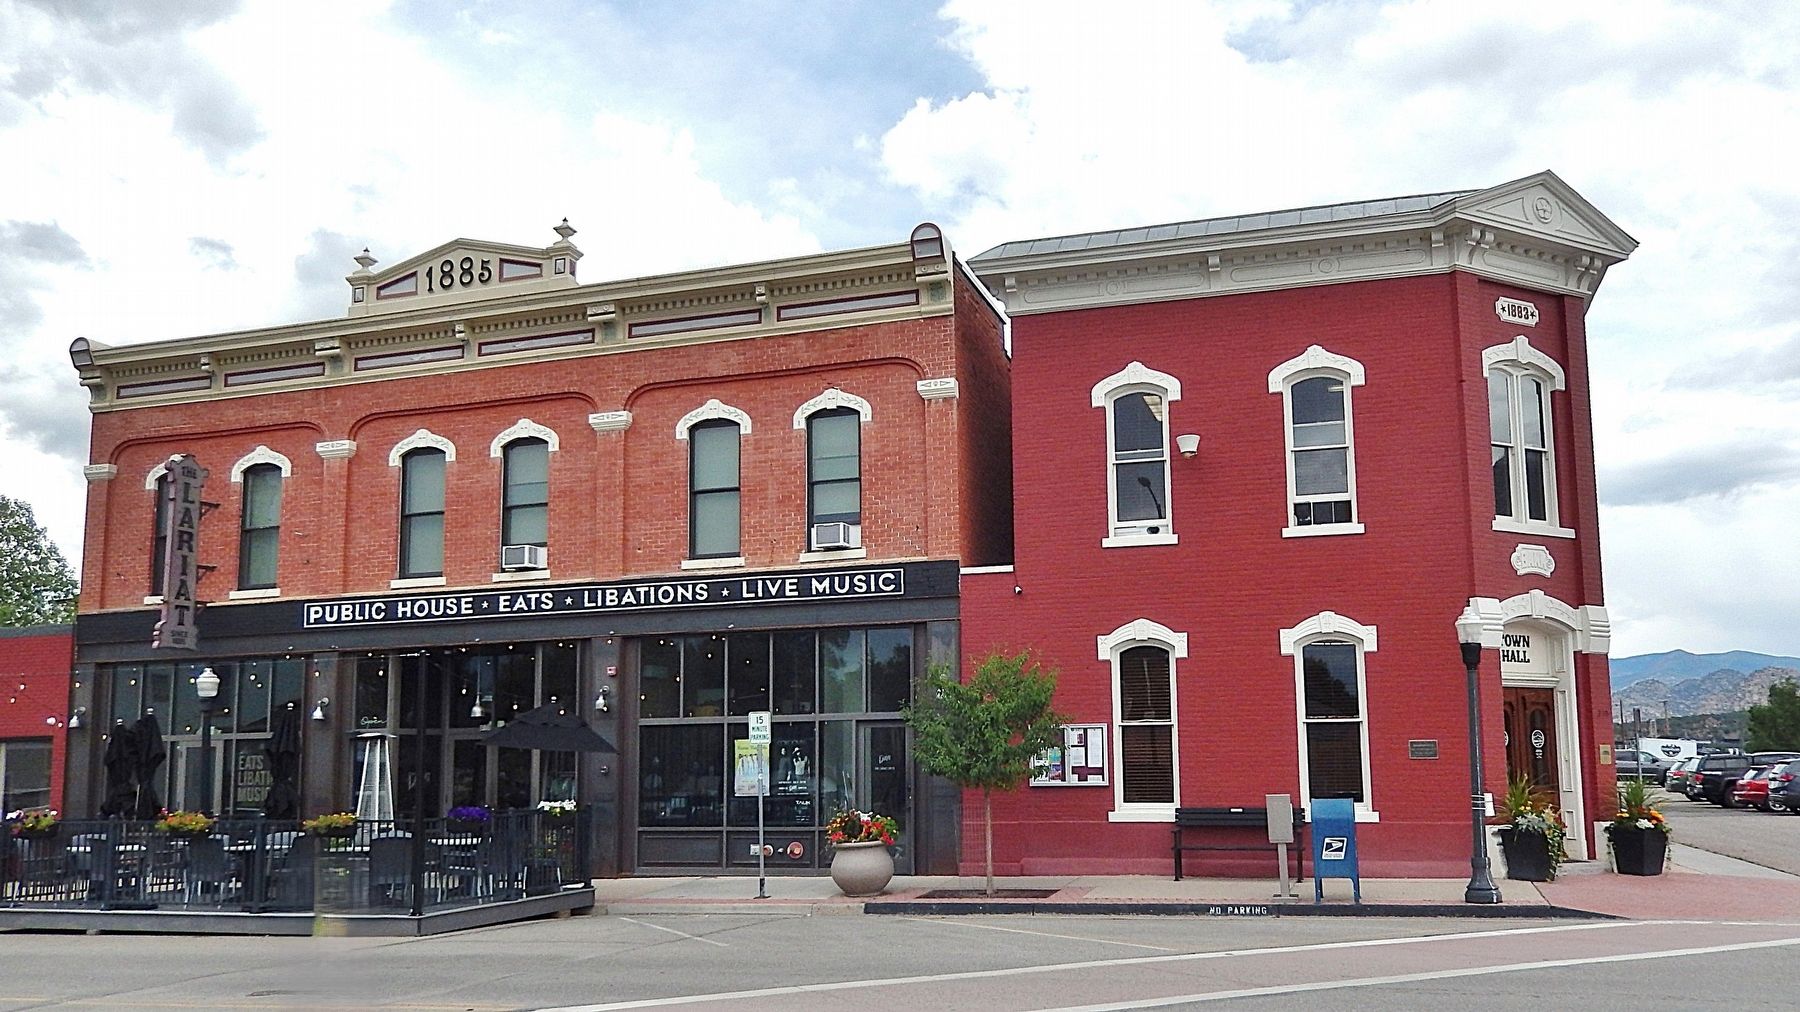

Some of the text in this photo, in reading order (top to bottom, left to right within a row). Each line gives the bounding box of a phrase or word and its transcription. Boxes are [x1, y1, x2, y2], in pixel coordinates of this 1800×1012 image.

[426, 256, 492, 293] 1885
[1507, 303, 1530, 320] 1883
[181, 466, 197, 479] THE
[175, 482, 196, 627] LARIAT
[309, 572, 897, 624] PUBLIC HOUSE EATS LIBATIONS LIVE MUSIC
[1501, 634, 1530, 648] OWN
[1501, 650, 1530, 663] HALL
[755, 715, 764, 725] 15
[239, 754, 264, 770] EATS
[237, 770, 274, 786] LIBATI
[1209, 906, 1268, 915] NO PARKING
